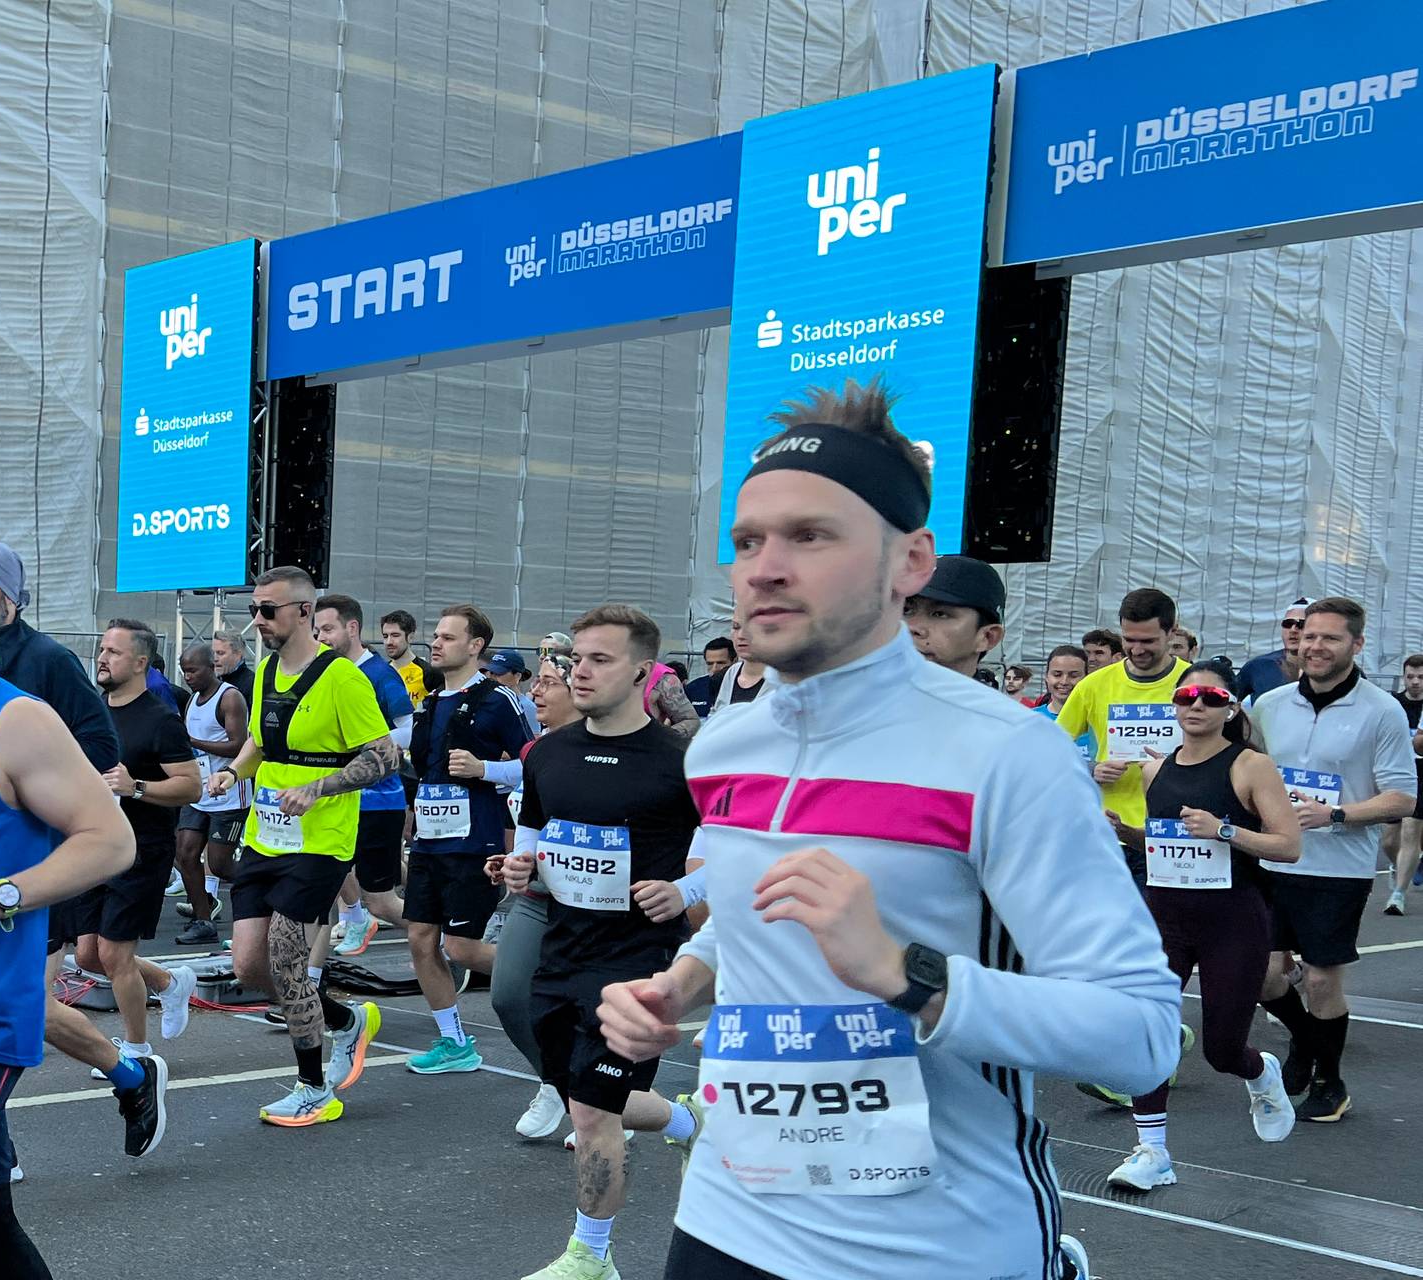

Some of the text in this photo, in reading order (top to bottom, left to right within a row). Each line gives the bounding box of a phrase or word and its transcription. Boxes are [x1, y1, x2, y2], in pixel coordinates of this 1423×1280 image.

[1136, 68, 1419, 145] DÜSSELDORF
[1047, 129, 1097, 168] uni
[807, 147, 880, 208] uni
[1055, 156, 1114, 195] per
[560, 198, 733, 251] DÜSSELDORF
[817, 193, 907, 256] per
[505, 235, 537, 265] uni
[510, 257, 547, 287] per
[288, 249, 463, 332] START
[160, 294, 198, 336] uni
[790, 305, 945, 345] Stadtsparkasse
[166, 327, 212, 370] per
[789, 340, 898, 373] Düsseldorf
[153, 409, 234, 433] Stadtsparkasse
[152, 432, 210, 454] Düsseldorf
[132, 503, 230, 537] D.SPORTS
[1116, 726, 1173, 737] 12943
[418, 805, 460, 816] 16070
[547, 852, 616, 875] 14382
[1159, 845, 1212, 859] 11714
[565, 874, 594, 885] NIKLAS
[718, 1008, 742, 1031] uni
[766, 1008, 802, 1032] uni
[835, 1007, 878, 1031] uni
[718, 1030, 748, 1053] per
[775, 1031, 816, 1055] per
[847, 1028, 896, 1053] per
[595, 1062, 623, 1078] JAKO
[722, 1079, 890, 1117] 12793
[778, 1126, 845, 1144] ANDRE
[848, 1166, 930, 1181] D.SPORTS
